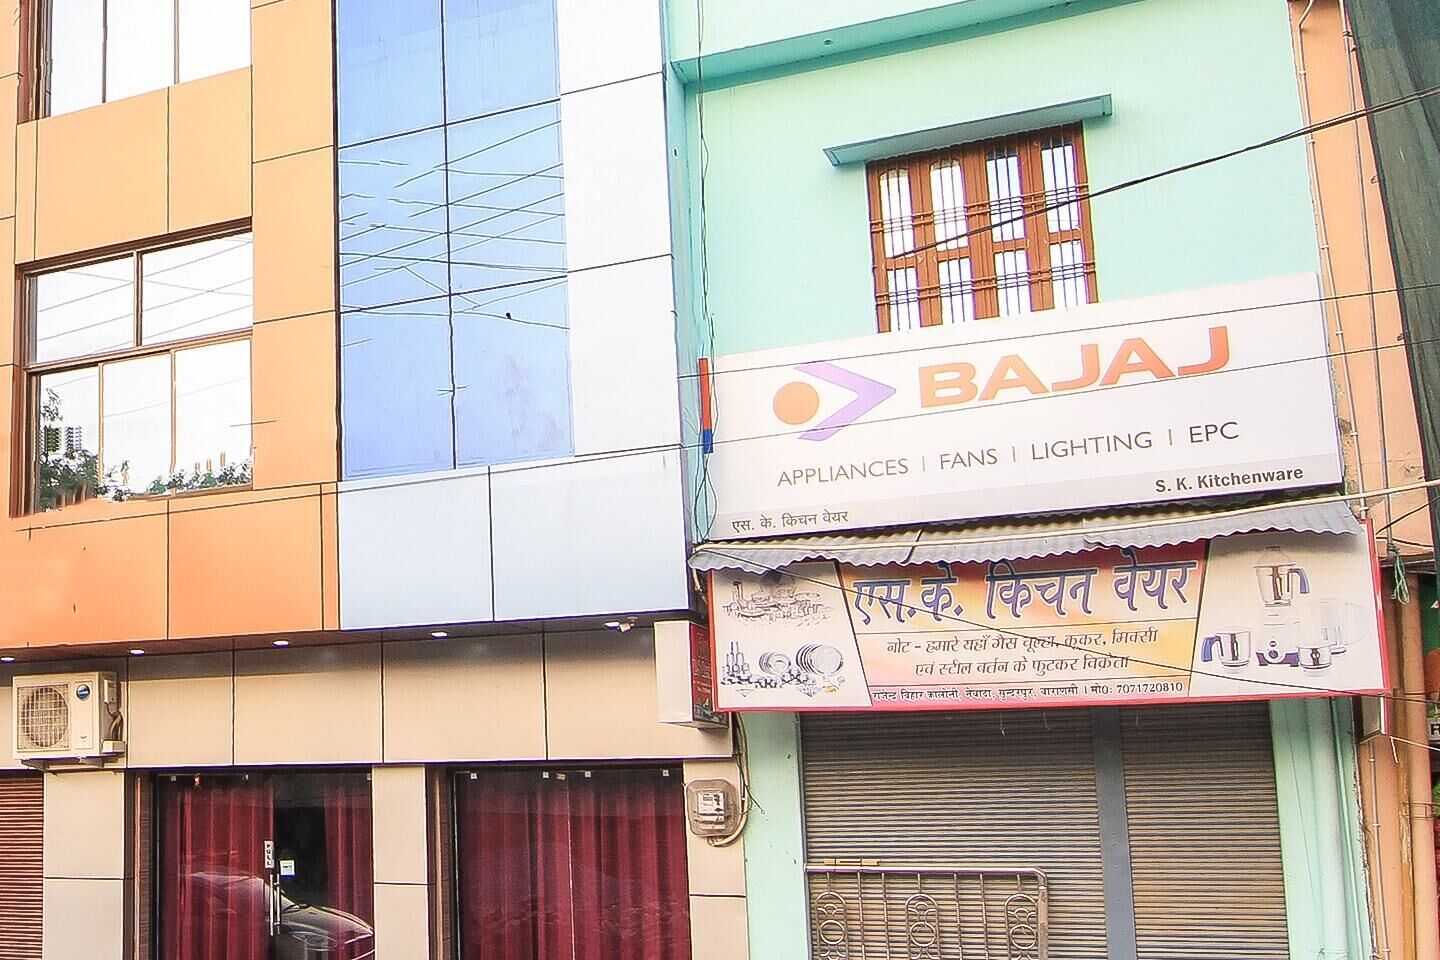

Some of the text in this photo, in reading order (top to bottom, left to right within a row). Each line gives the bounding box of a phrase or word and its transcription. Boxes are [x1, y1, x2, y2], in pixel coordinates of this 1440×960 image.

[918, 325, 1230, 409] BAJAJ
[777, 421, 1240, 487] APPLIANCES FANS LIGHTING EPC
[1155, 467, 1304, 493] S. K. Kitchenware
[782, 511, 817, 528] किचन
[822, 508, 849, 524] वेयर
[985, 559, 1098, 620] किचन
[1113, 547, 1198, 612] वेयर
[926, 636, 960, 653] हमारे
[963, 634, 991, 651] यहाँ
[991, 634, 1019, 650] गैस
[915, 662, 936, 676] एवं
[939, 659, 973, 675] स्टील
[977, 658, 1010, 674] बर्तन
[1013, 656, 1029, 673] के
[1032, 658, 1080, 676] फुटकर
[1040, 683, 1079, 696] वाराणसी
[1116, 681, 1183, 695] 7071720810
